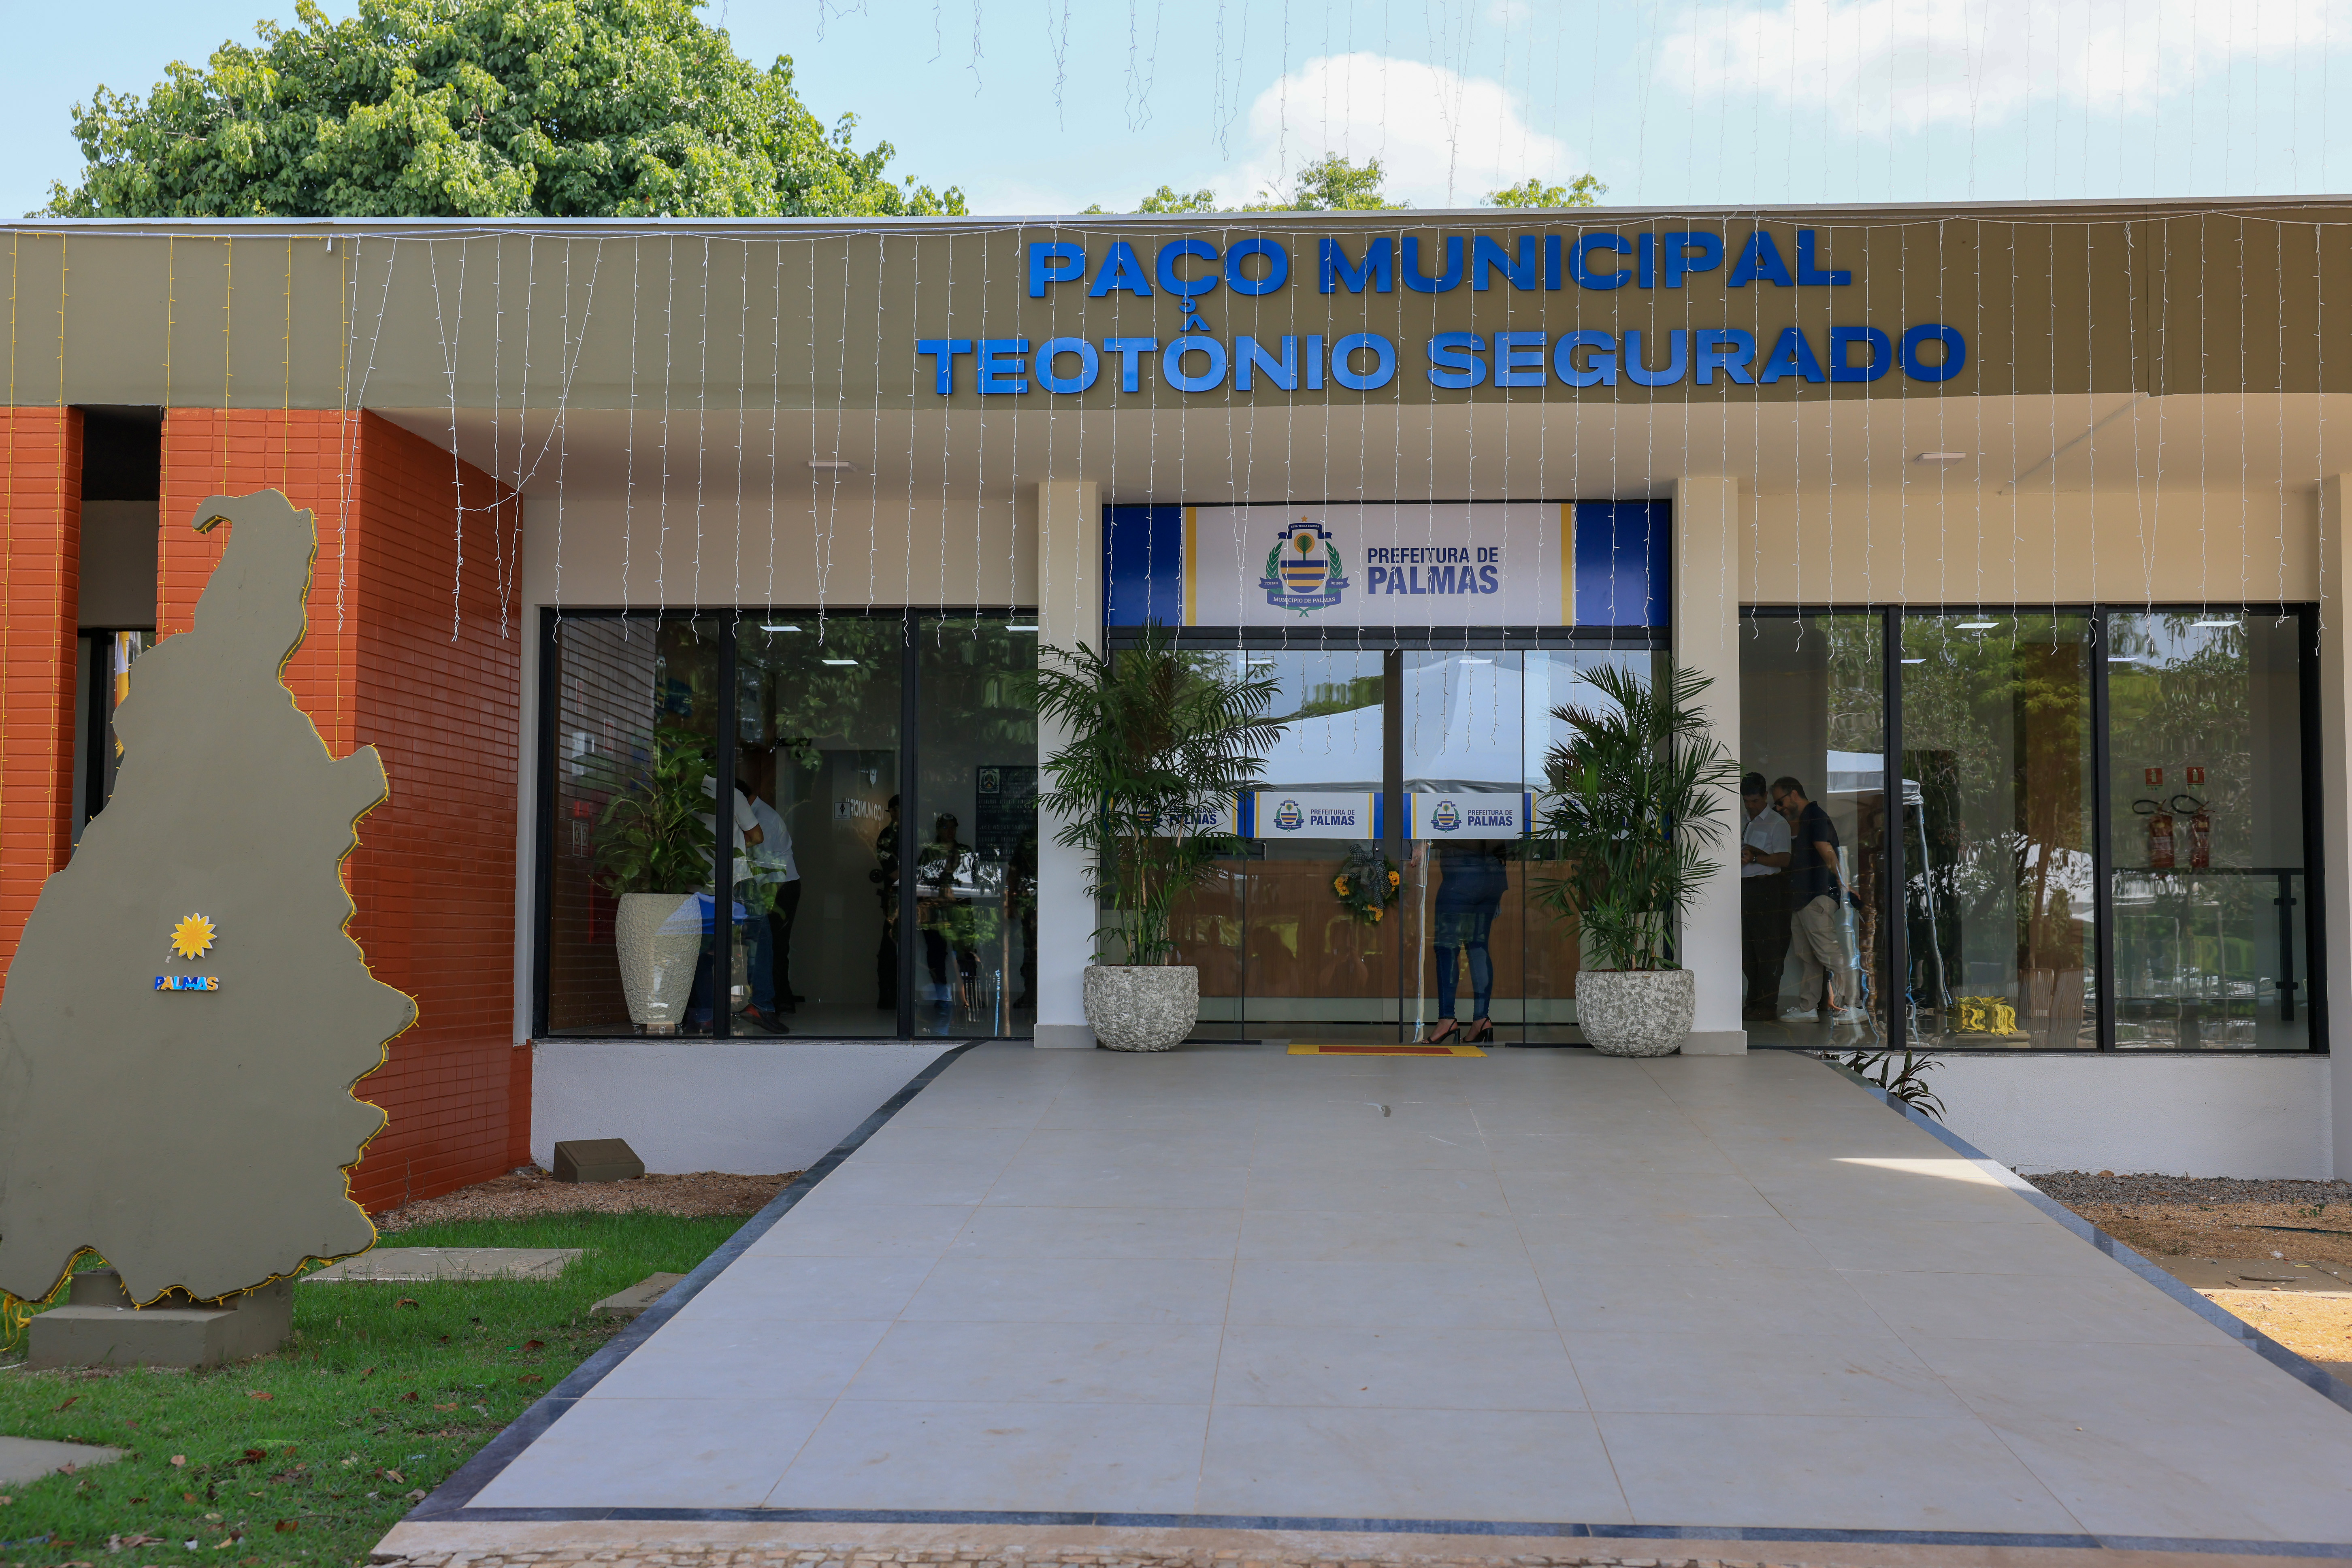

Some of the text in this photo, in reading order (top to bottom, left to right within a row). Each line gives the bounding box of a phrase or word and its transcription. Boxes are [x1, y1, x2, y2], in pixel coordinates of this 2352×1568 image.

[1029, 230, 1851, 313] PAÇO MUNICIPAL
[917, 314, 1966, 394] TEOTÔNIO SEGURADO
[1368, 548, 1499, 563] PREFEITURA DE
[1368, 565, 1499, 594] PALMAS
[1310, 816, 1355, 826] PALMAS
[1468, 816, 1513, 826] PALMAS
[154, 976, 219, 991] PALMAS
